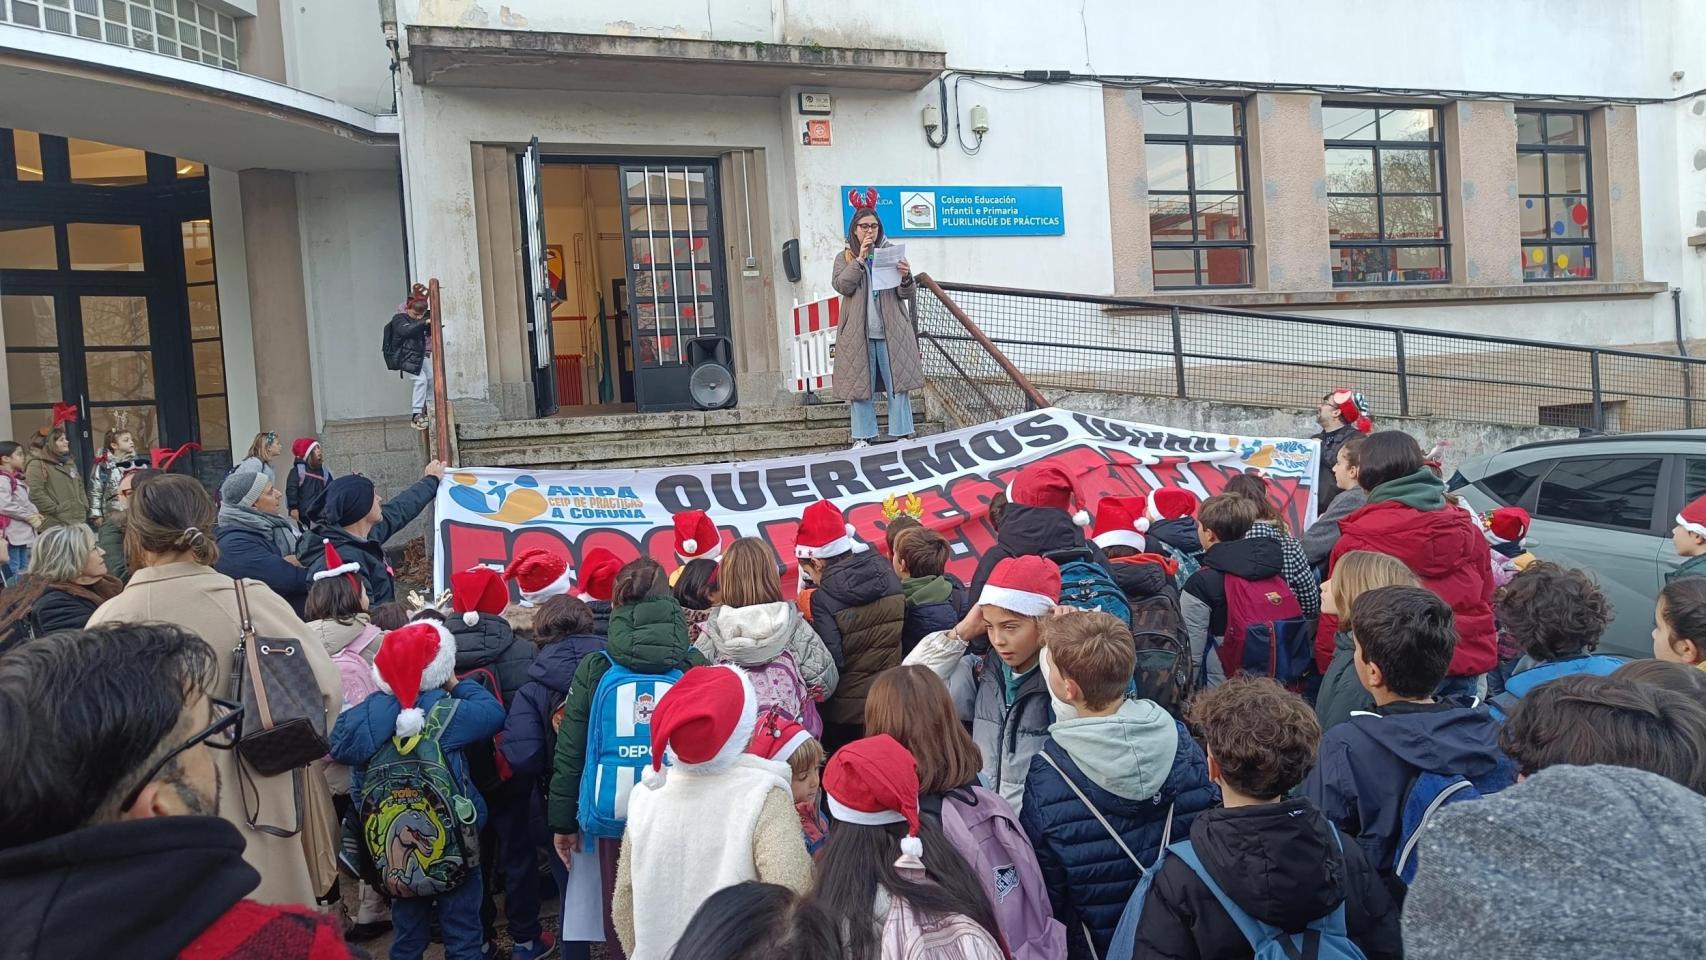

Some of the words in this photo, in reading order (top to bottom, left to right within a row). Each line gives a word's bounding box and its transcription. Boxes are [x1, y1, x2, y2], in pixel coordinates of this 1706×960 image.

[941, 195, 972, 204] Colexio
[975, 195, 1016, 204] Educación
[942, 206, 974, 215] Infantil
[983, 207, 1018, 215] Primaria
[942, 216, 999, 226] PLURILINGÜE
[1000, 217, 1012, 226] DE
[1014, 216, 1060, 226] PRÁCTICAS
[654, 413, 1069, 514] QUEREMOS
[547, 485, 639, 499] ANPA
[548, 497, 570, 507] CEIP
[574, 497, 586, 508] DE
[552, 507, 564, 518] A
[570, 507, 646, 519] CORUÑA
[619, 745, 653, 758] DEP
